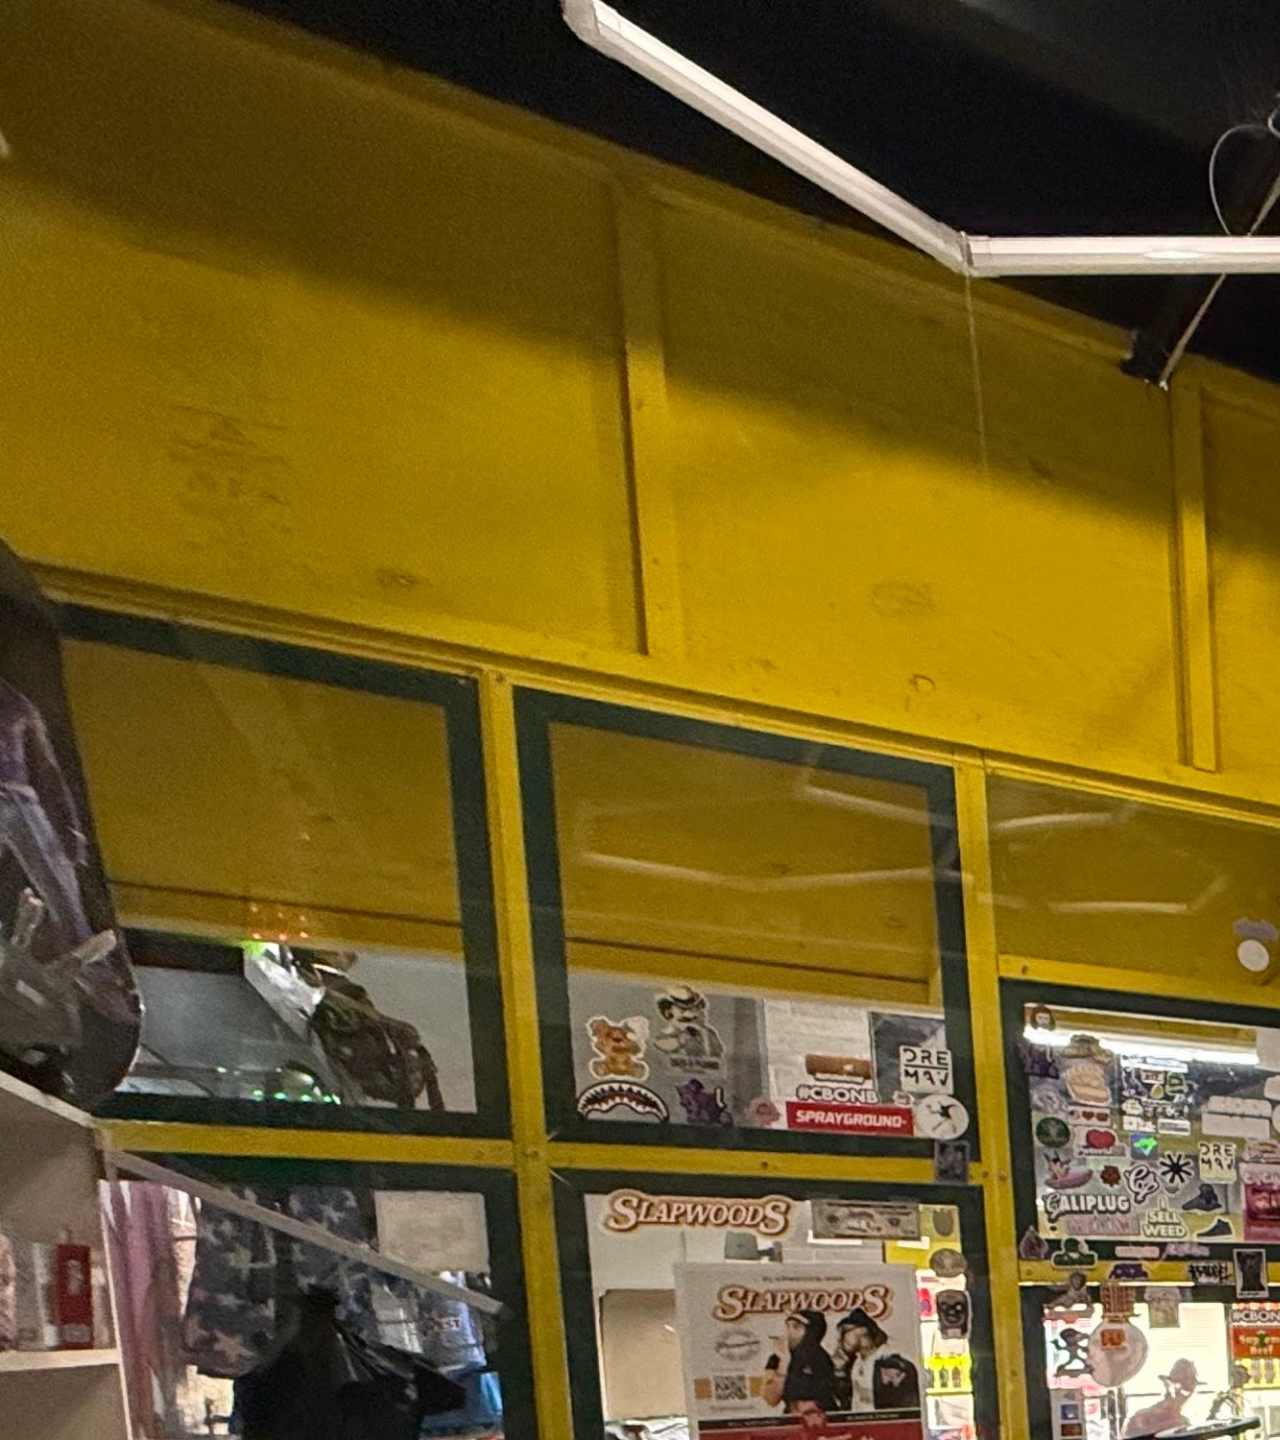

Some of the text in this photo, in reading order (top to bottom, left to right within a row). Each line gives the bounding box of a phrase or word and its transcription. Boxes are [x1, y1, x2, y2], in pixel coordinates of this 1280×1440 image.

[795, 1109, 903, 1129] SPRAYGROUND
[606, 1193, 790, 1234] SLAPWOODS
[1147, 1210, 1180, 1225] SELL
[1143, 1224, 1186, 1238] WEED
[714, 1284, 890, 1321] SLAPWOODS
